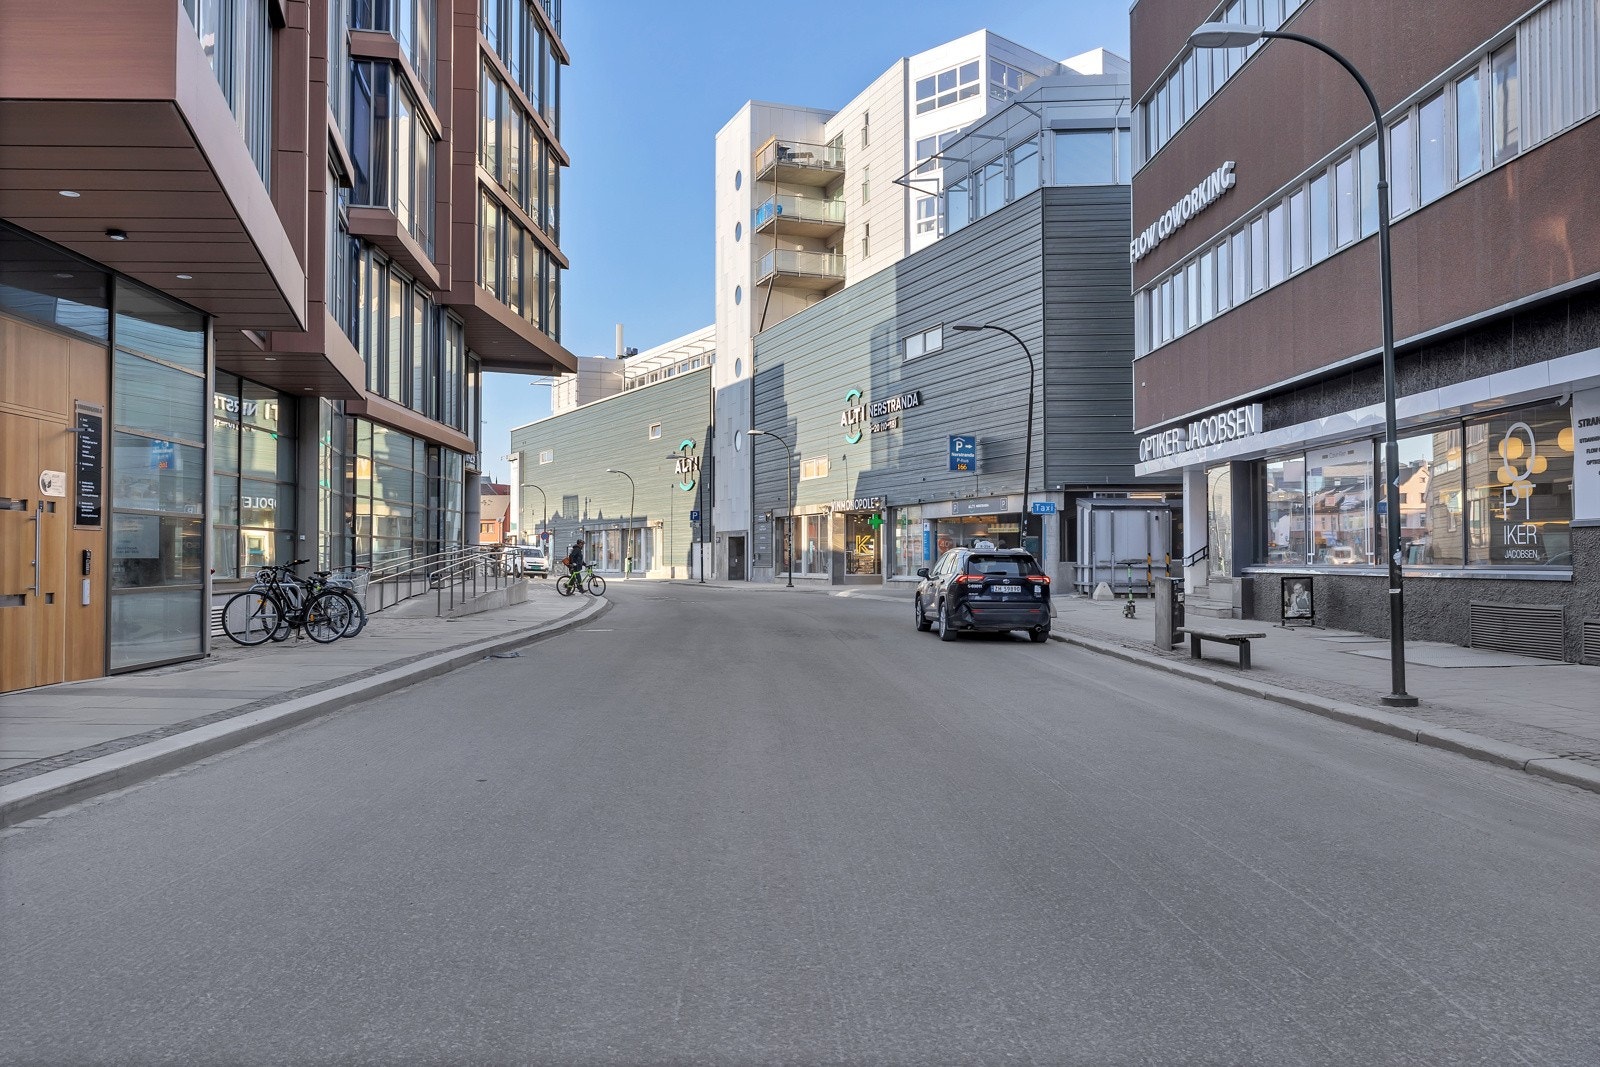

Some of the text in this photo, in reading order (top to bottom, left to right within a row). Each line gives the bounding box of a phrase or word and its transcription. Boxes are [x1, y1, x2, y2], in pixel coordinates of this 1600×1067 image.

[1130, 161, 1235, 263] FLOW COWORKING
[840, 392, 919, 427] ALTI NERSTRANDA
[1139, 404, 1260, 462] OPTIKER JACOBSEN
[1035, 503, 1054, 512] Taxi
[1503, 524, 1538, 545] IKER
[1504, 549, 1538, 559] JACOBSEN
